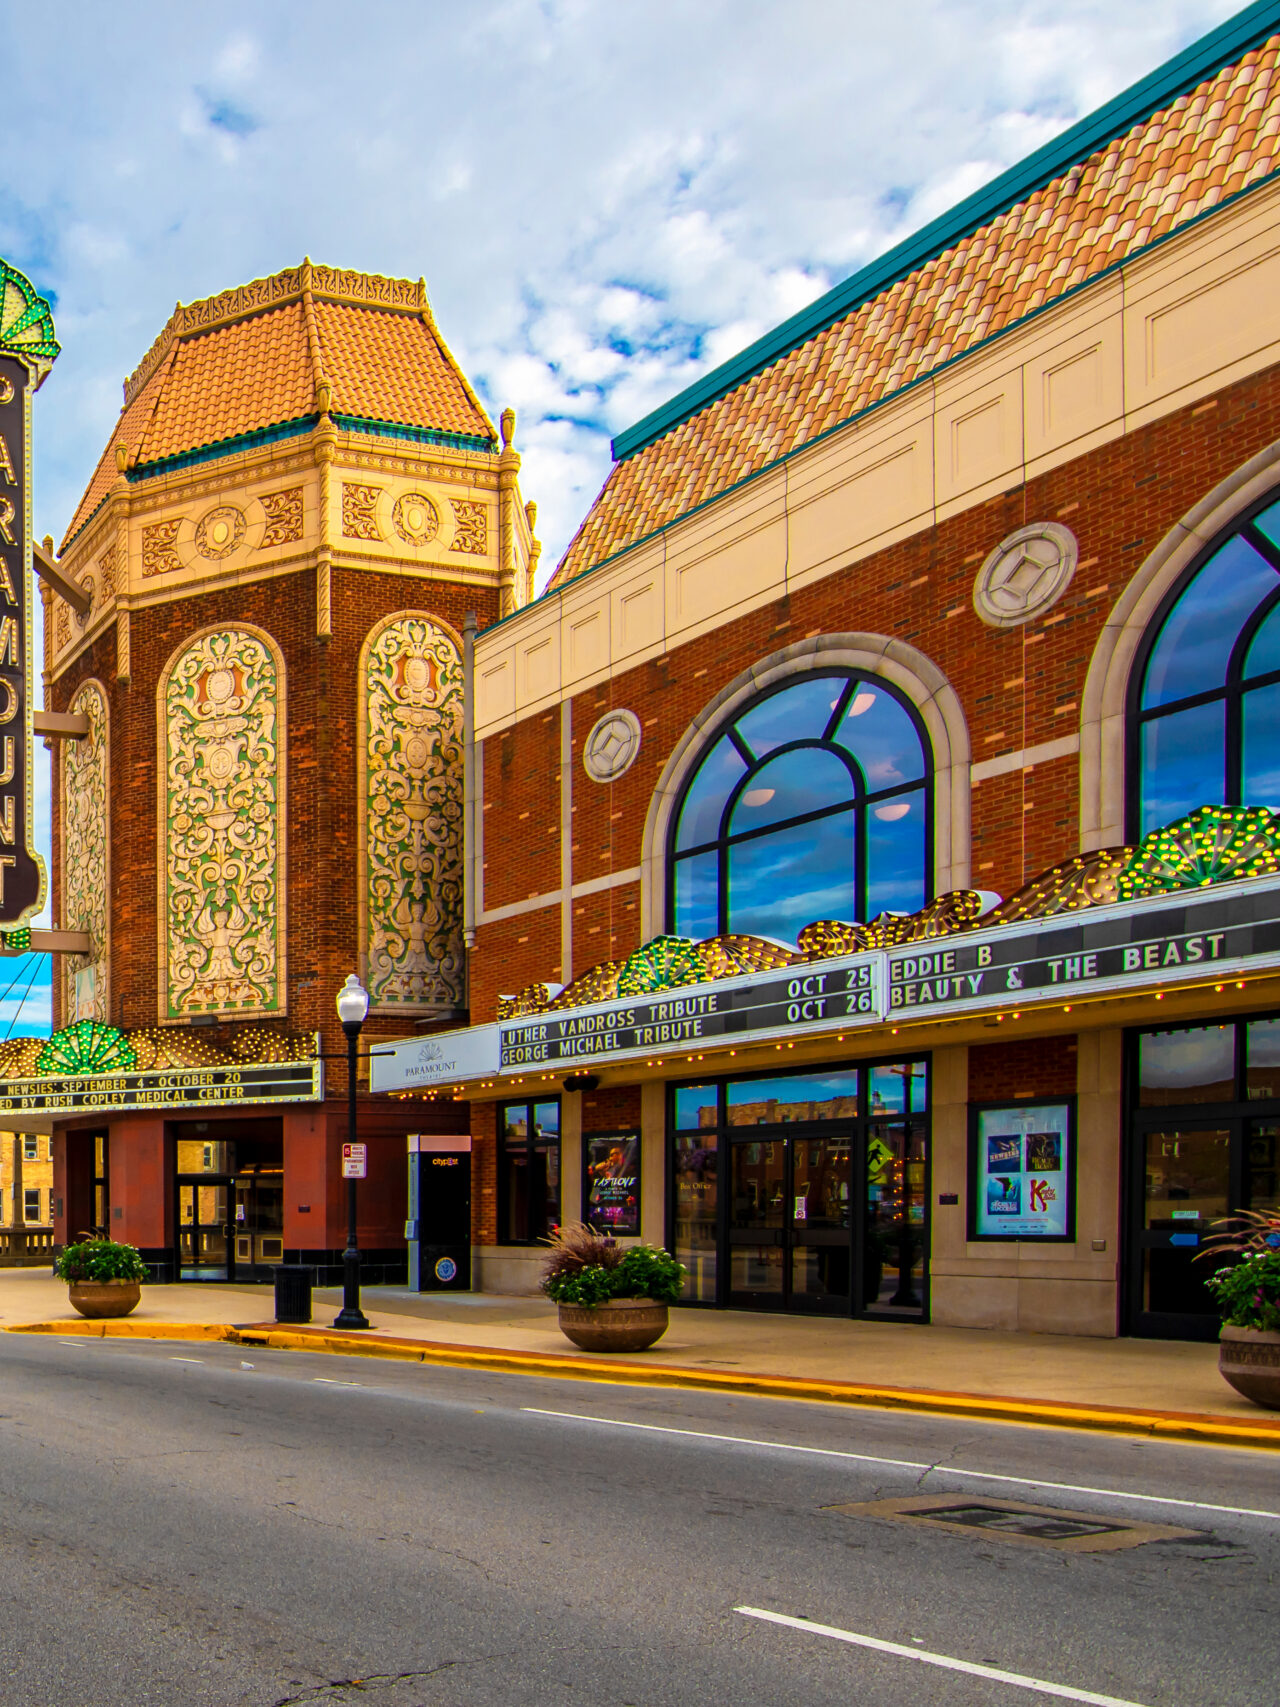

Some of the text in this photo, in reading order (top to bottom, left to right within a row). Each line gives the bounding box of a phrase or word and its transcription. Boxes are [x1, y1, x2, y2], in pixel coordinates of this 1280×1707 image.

[891, 945, 993, 981] EDDIE B
[891, 934, 1225, 1007] BEAUTY & THE BEAST
[501, 967, 870, 1046] LUTHER VANDROSS TRIBUTE OCT 25
[501, 991, 871, 1065] GEORGE MICHAEL TRIBUTE OCT 26
[405, 1061, 456, 1077] PARAMOUNT
[62, 1079, 127, 1093] SEPTEMBER
[136, 1078, 145, 1089] 4
[158, 1074, 214, 1087] OCTOBER
[224, 1072, 241, 1084] 20
[21, 1097, 37, 1108] BY
[45, 1095, 73, 1107] RUSH
[82, 1093, 126, 1105] COPLEY
[136, 1090, 188, 1103] MEDICAL
[198, 1086, 244, 1100] CENTER
[593, 1177, 637, 1188] FASTLOVE
[680, 1182, 712, 1190] Box Office
